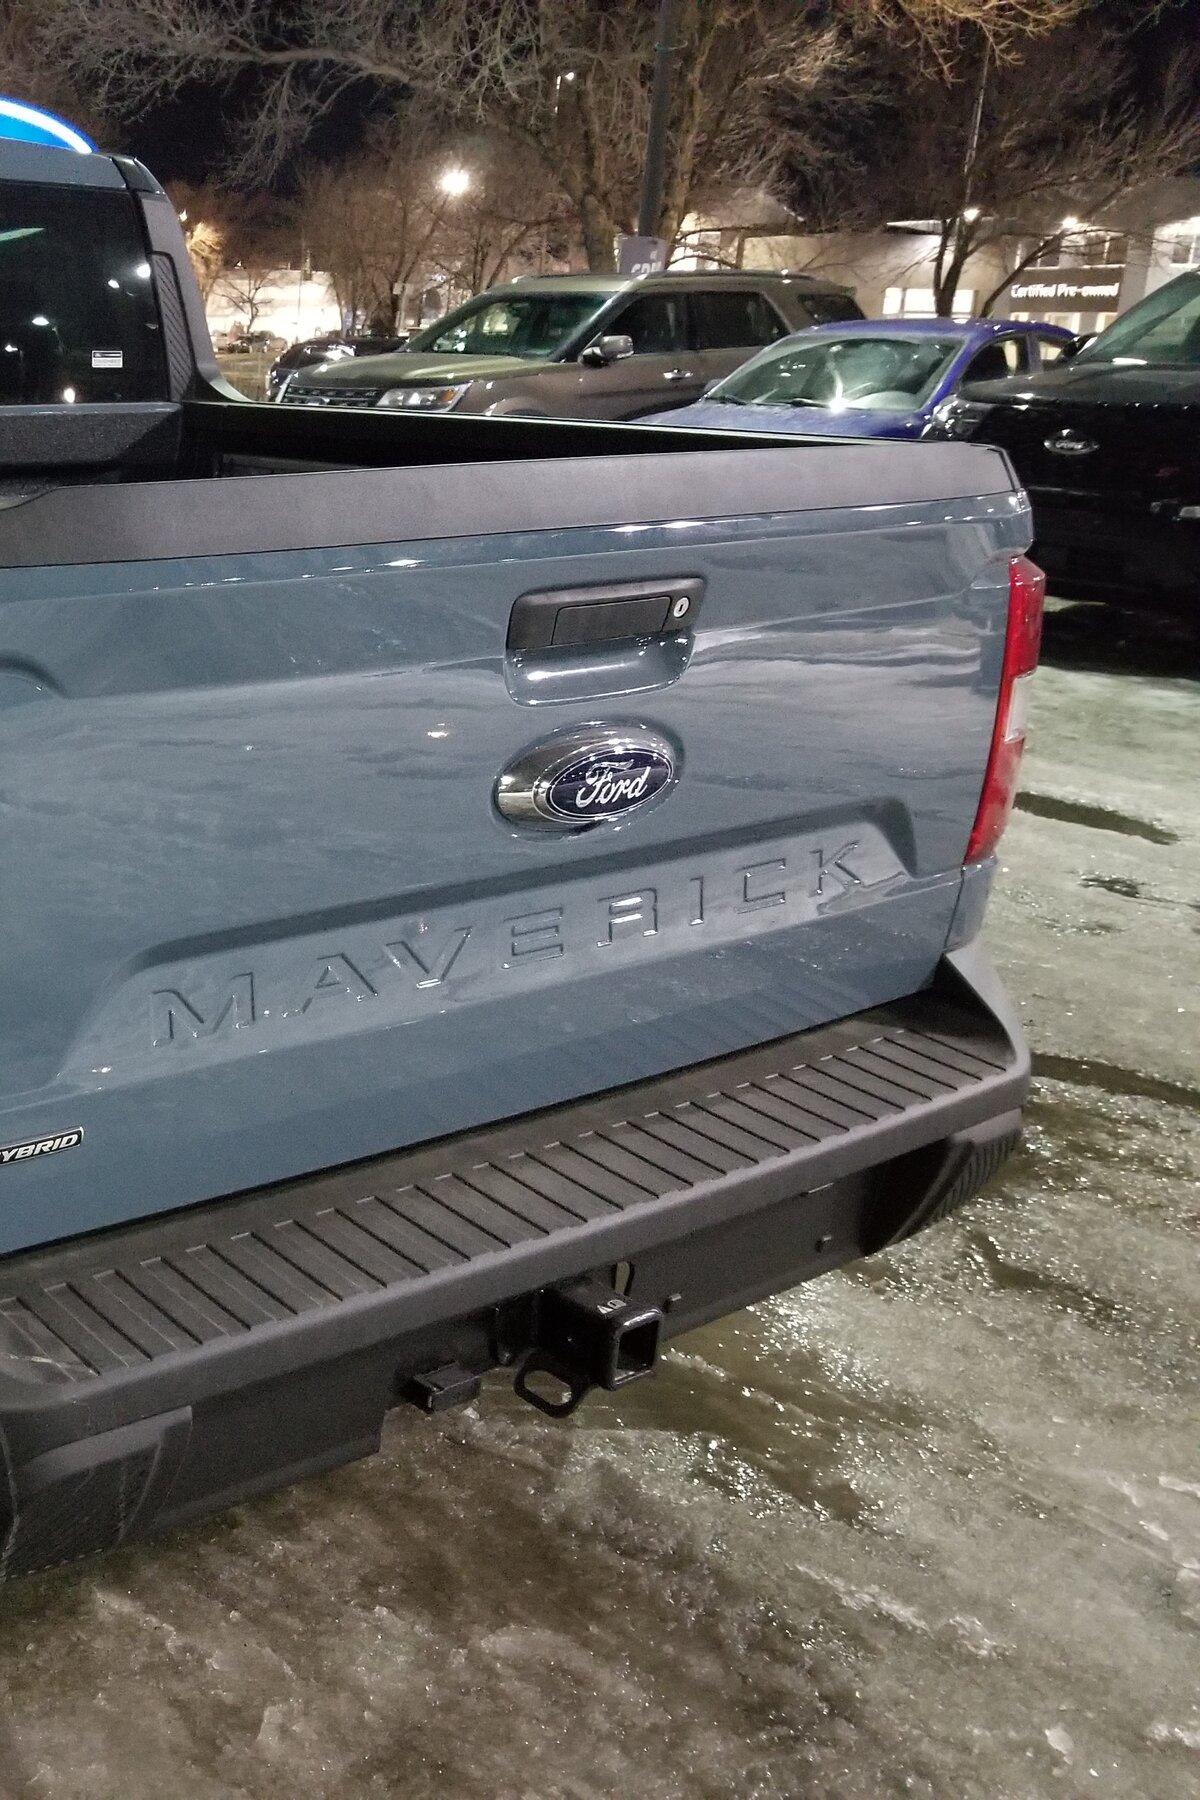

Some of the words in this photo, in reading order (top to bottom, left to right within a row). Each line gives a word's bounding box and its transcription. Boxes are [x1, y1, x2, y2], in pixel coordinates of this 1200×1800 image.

[1011, 283, 1057, 298] Certified
[575, 759, 652, 808] Ford
[152, 840, 863, 1048] MAVERICK
